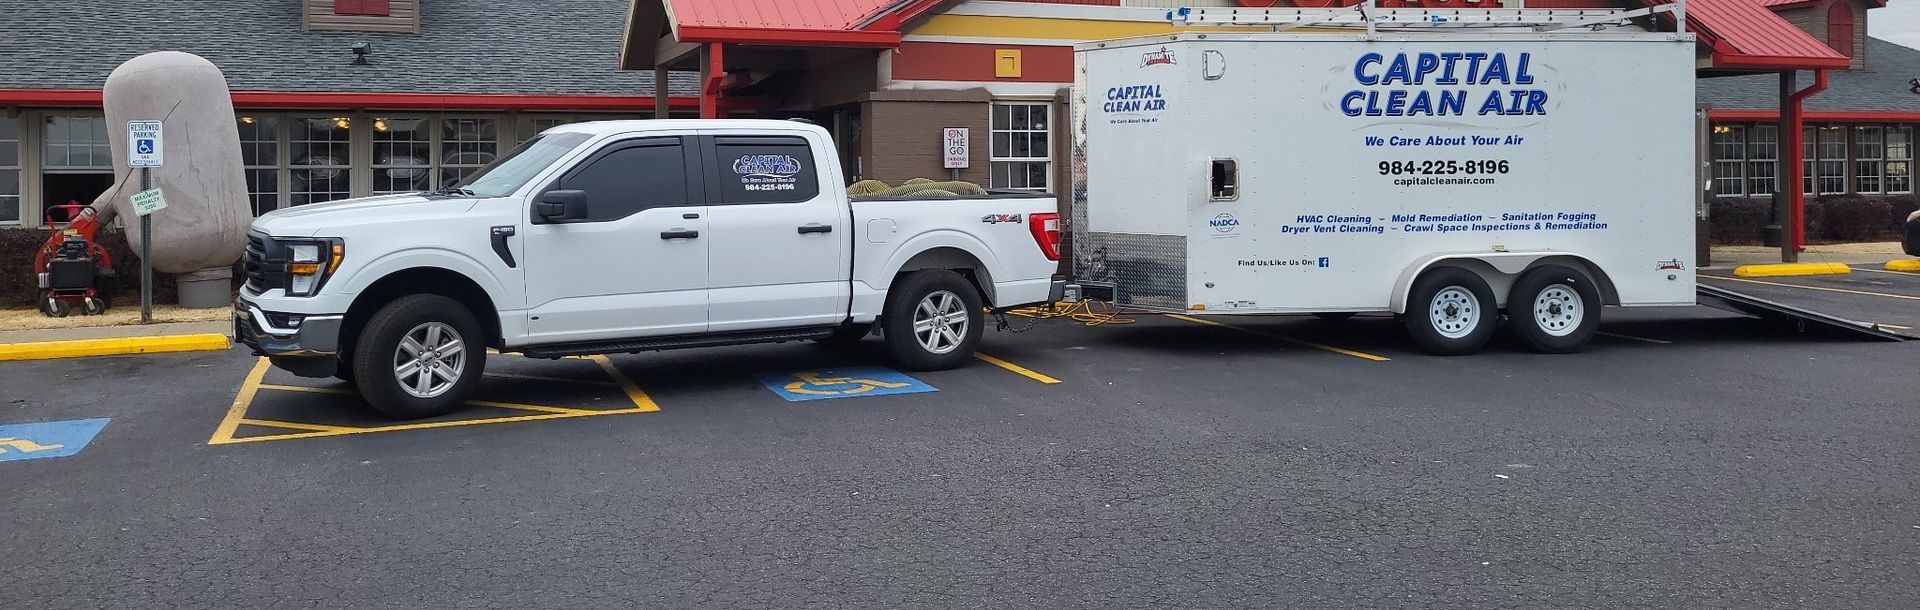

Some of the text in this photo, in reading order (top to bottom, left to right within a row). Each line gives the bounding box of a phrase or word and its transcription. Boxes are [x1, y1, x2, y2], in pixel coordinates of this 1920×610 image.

[1353, 52, 1534, 85] CAPITAL
[1107, 85, 1161, 100] CAPITAL
[1103, 99, 1166, 112] CLEAN AIR
[1340, 90, 1548, 116] CLEAN AIR
[948, 130, 964, 138] ON
[948, 138, 965, 147] THE
[1365, 135, 1524, 147] We Care About Your Air
[950, 147, 964, 155] GO
[740, 155, 792, 165] CAPITAL
[738, 165, 797, 174] CLEAN AIR
[1378, 160, 1510, 175] 984-225-8196
[744, 183, 795, 191] 984-225-8196
[1393, 177, 1495, 187] capitalcleanair.com
[1209, 218, 1240, 227] NADCA
[1296, 215, 1323, 223] HVAC
[1327, 215, 1372, 225] Cleaning
[1391, 214, 1416, 223] Mold
[1419, 213, 1483, 222] Remediation
[1502, 213, 1554, 221] Sanitation
[1557, 212, 1597, 222] Fogging
[1281, 225, 1310, 235] Dryer
[1314, 225, 1336, 233] Vent
[1341, 225, 1384, 235] Cleaning
[1404, 224, 1434, 232] Crawl
[1436, 223, 1468, 233] Space
[1471, 223, 1531, 233] Inspections
[1534, 222, 1542, 231] &
[1545, 221, 1608, 230] Remediation
